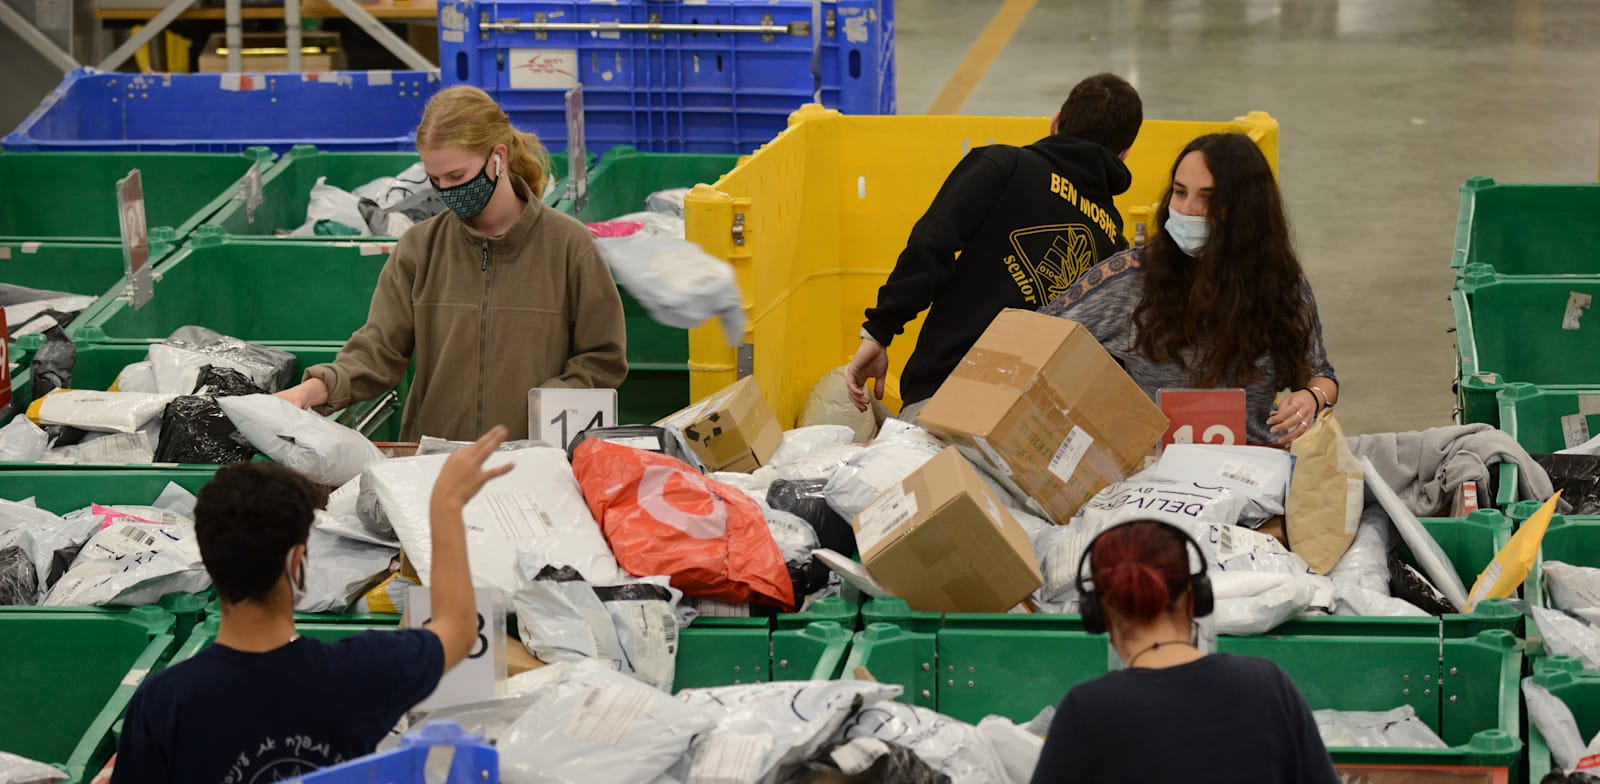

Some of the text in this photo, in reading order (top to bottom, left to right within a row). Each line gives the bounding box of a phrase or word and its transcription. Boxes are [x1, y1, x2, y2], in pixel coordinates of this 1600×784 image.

[1050, 172, 1118, 246] BEN MOSHE
[1003, 254, 1037, 305] senior
